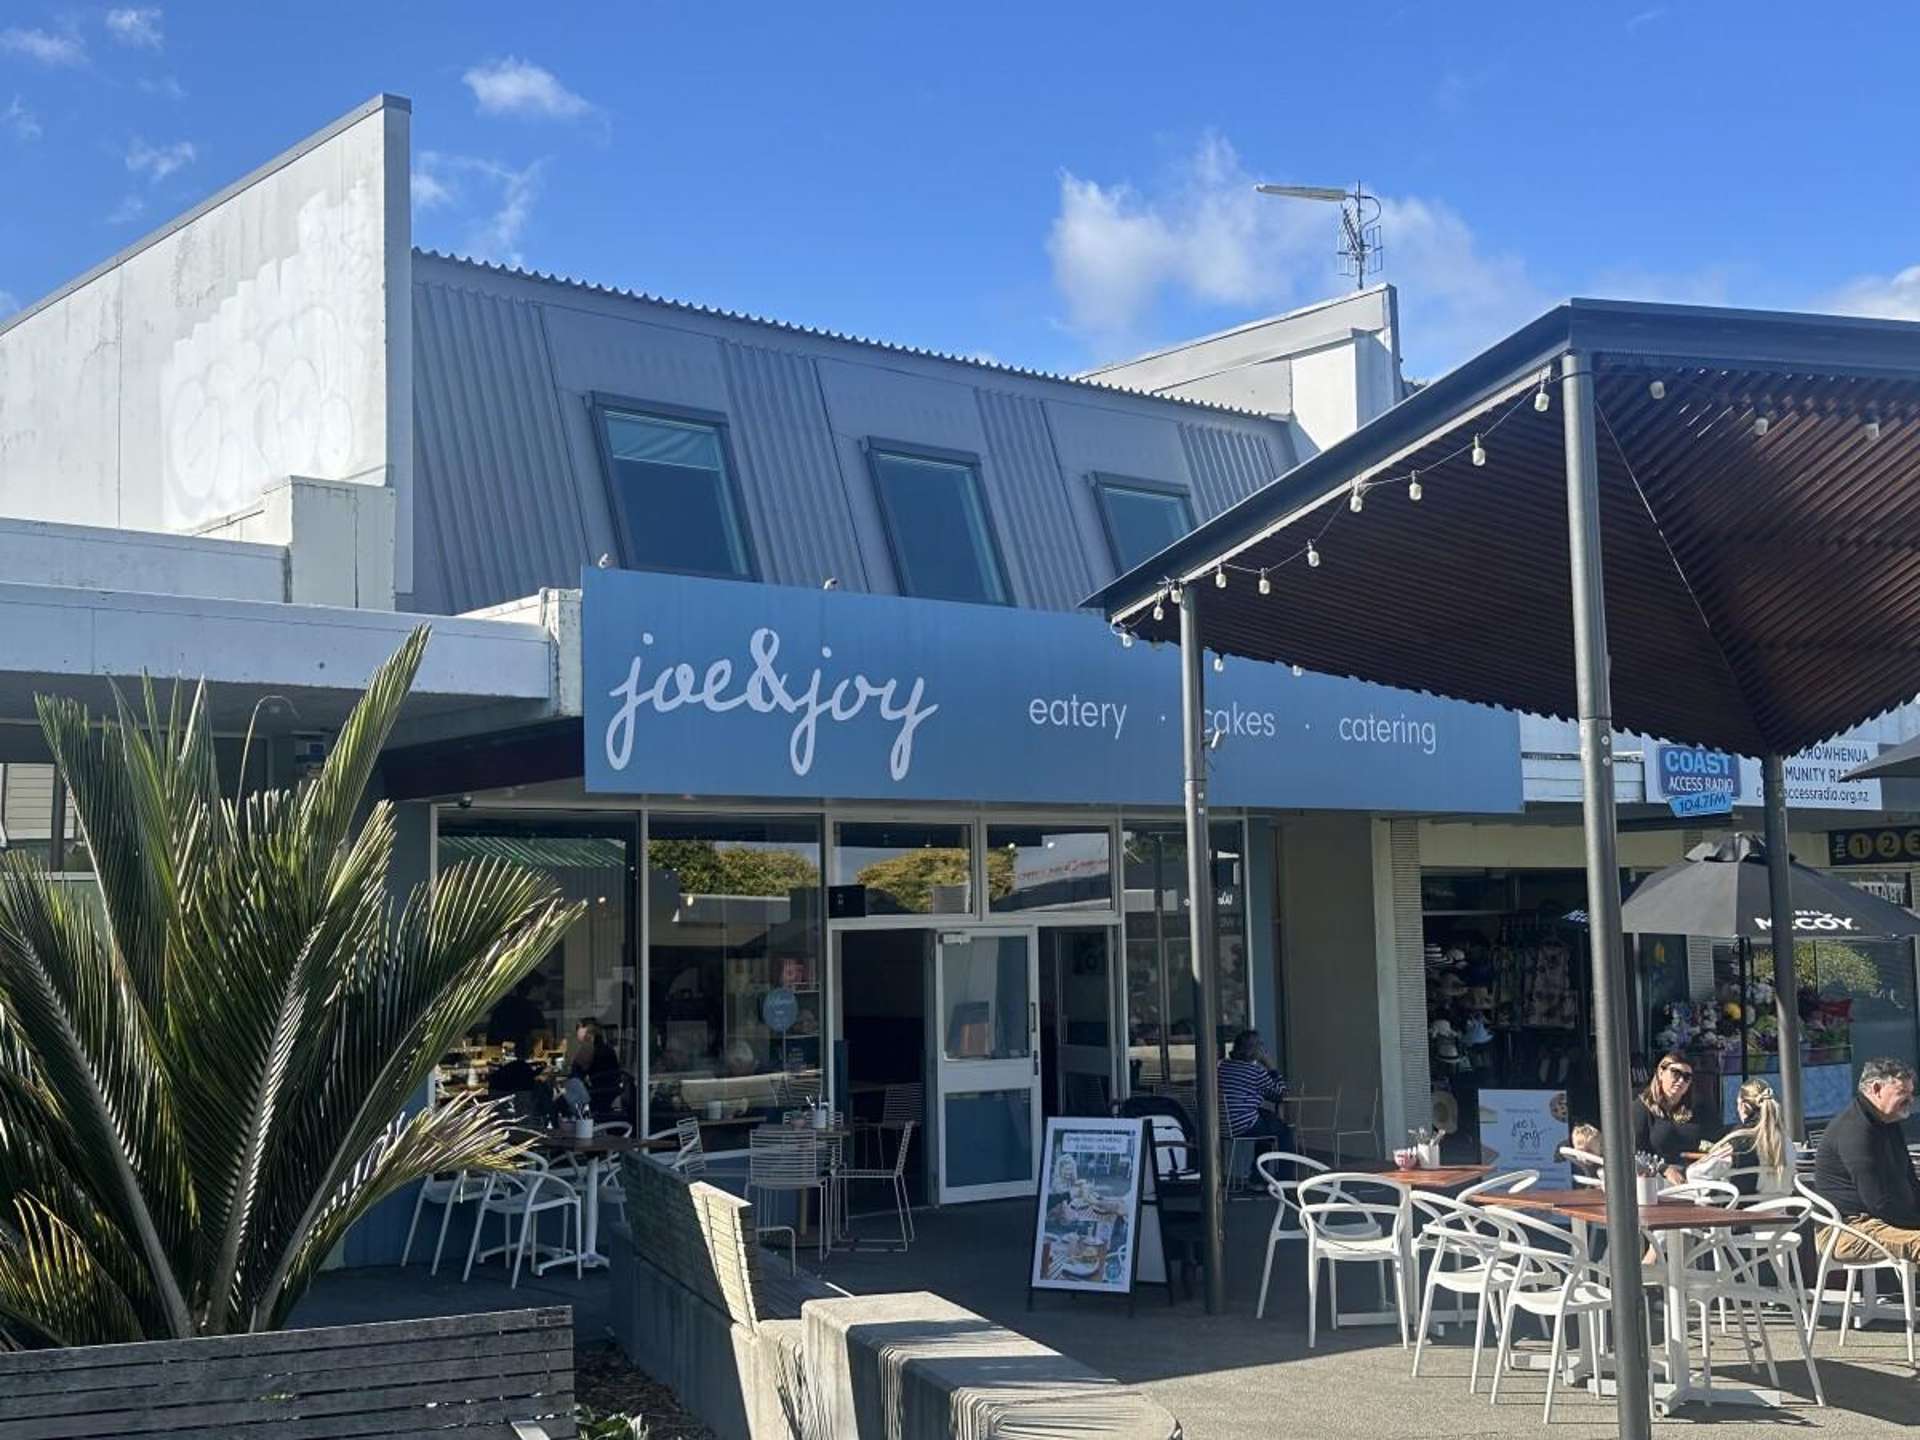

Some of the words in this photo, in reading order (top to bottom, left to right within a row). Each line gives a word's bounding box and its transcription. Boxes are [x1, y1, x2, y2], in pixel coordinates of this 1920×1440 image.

[605, 627, 939, 782] joe&joy
[1028, 693, 1127, 740] eatery
[1338, 713, 1437, 755] catering
[1664, 750, 1732, 775] COAST
[1799, 745, 1869, 762] OROWHENUA
[1668, 775, 1704, 792] ACCESS
[1705, 777, 1734, 793] RADIO
